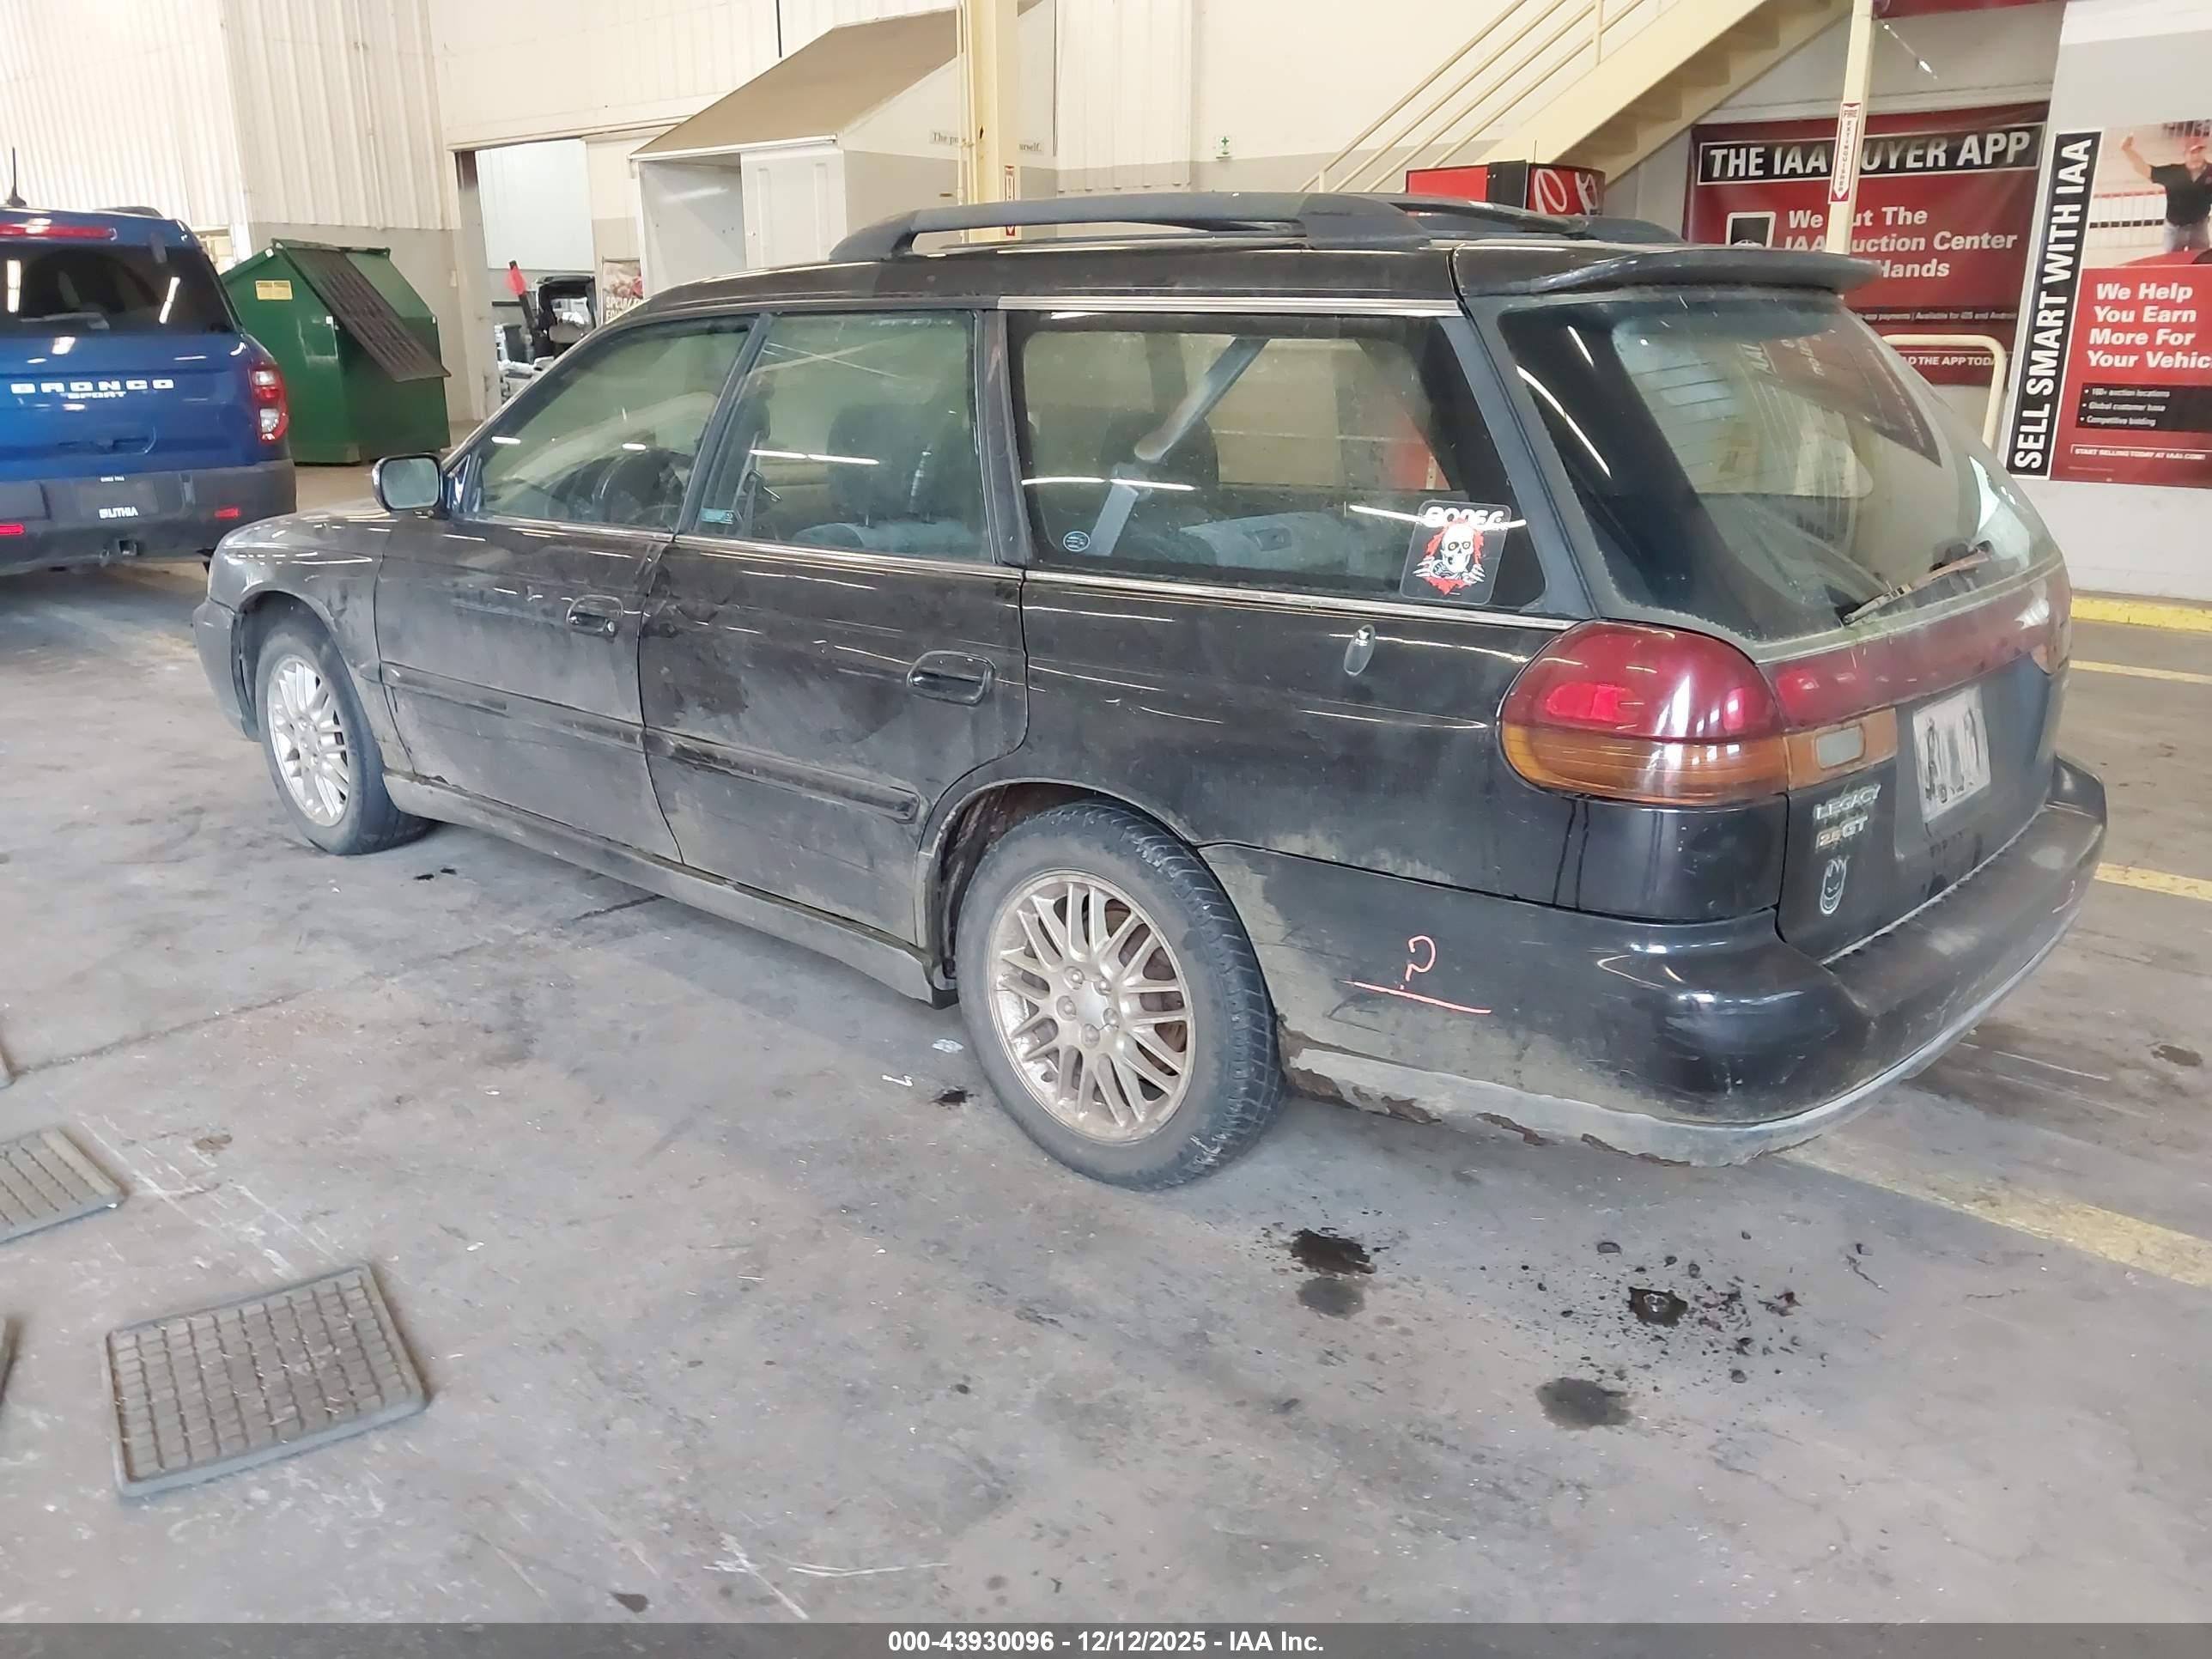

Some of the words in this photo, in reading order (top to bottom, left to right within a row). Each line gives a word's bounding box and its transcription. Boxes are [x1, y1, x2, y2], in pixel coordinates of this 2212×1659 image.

[1710, 147, 1765, 178] THE
[1773, 144, 1828, 175] IAA
[1861, 137, 1948, 171] UYER
[1956, 131, 2031, 167] APP
[2055, 138, 2093, 194] IAA
[1788, 210, 1824, 228] We
[1853, 209, 1874, 227] ut
[1881, 206, 1929, 226] The
[1784, 234, 1826, 250] IAA
[1852, 234, 1926, 252] uction
[1933, 231, 2018, 251] Center
[2042, 204, 2082, 284] WITH
[2096, 283, 2131, 300] We
[2138, 282, 2193, 303] Help
[2094, 305, 2136, 323] You
[2142, 305, 2197, 323] Earn
[2026, 290, 2068, 396] SMART
[2088, 328, 2148, 345] More
[2155, 328, 2196, 345] For
[1919, 356, 1939, 365] THE
[1942, 356, 1966, 365] APP
[2087, 349, 2139, 368] Your
[2146, 350, 2212, 368] Vehic
[10, 379, 174, 394] BRONCO
[67, 391, 126, 399] SPORT
[2014, 403, 2051, 469] SELL
[2075, 447, 2098, 456] START
[1814, 783, 1882, 820] LEGACY
